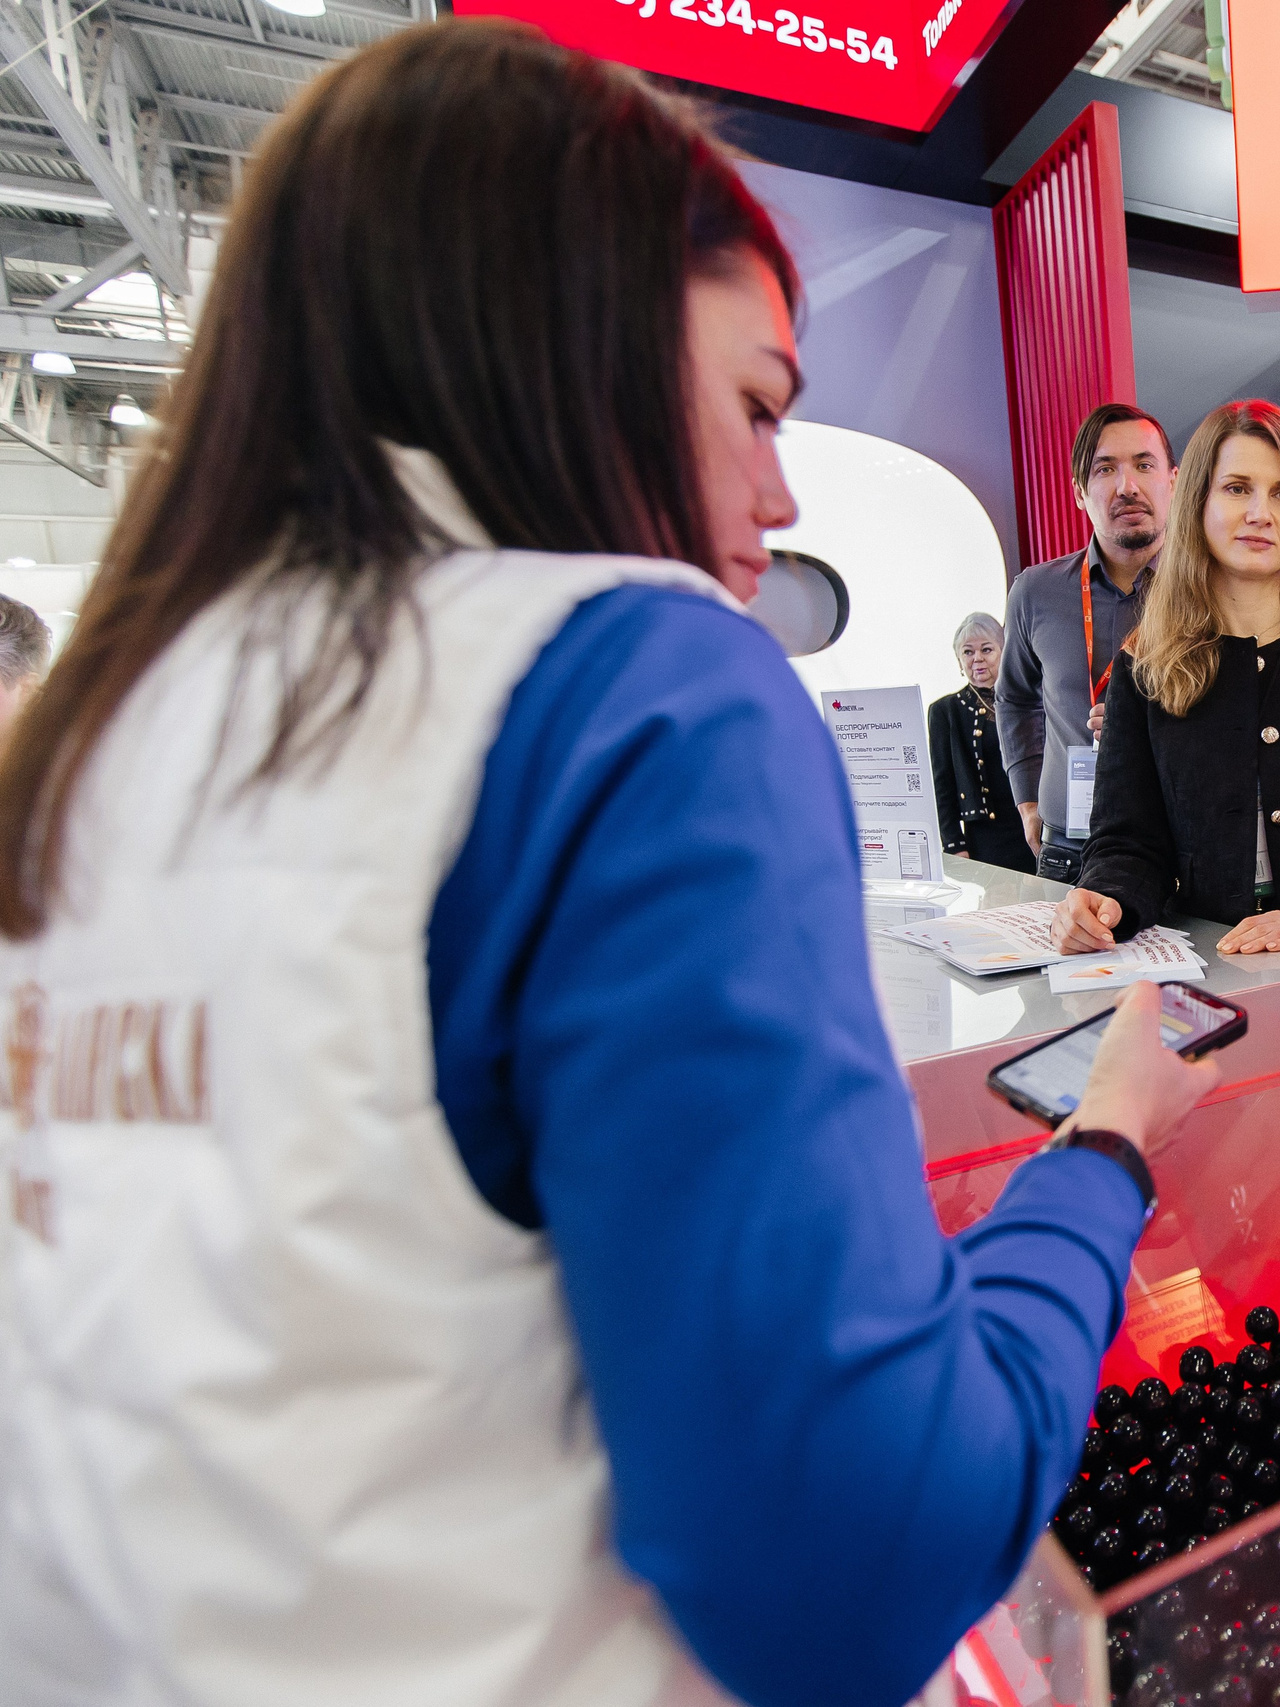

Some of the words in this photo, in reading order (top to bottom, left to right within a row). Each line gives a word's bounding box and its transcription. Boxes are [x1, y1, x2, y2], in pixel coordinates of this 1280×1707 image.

[669, 0, 898, 70] 234-25-54
[922, 0, 963, 57] Толь
[836, 722, 902, 732] БЕСПРОИГРЫШНАЯ
